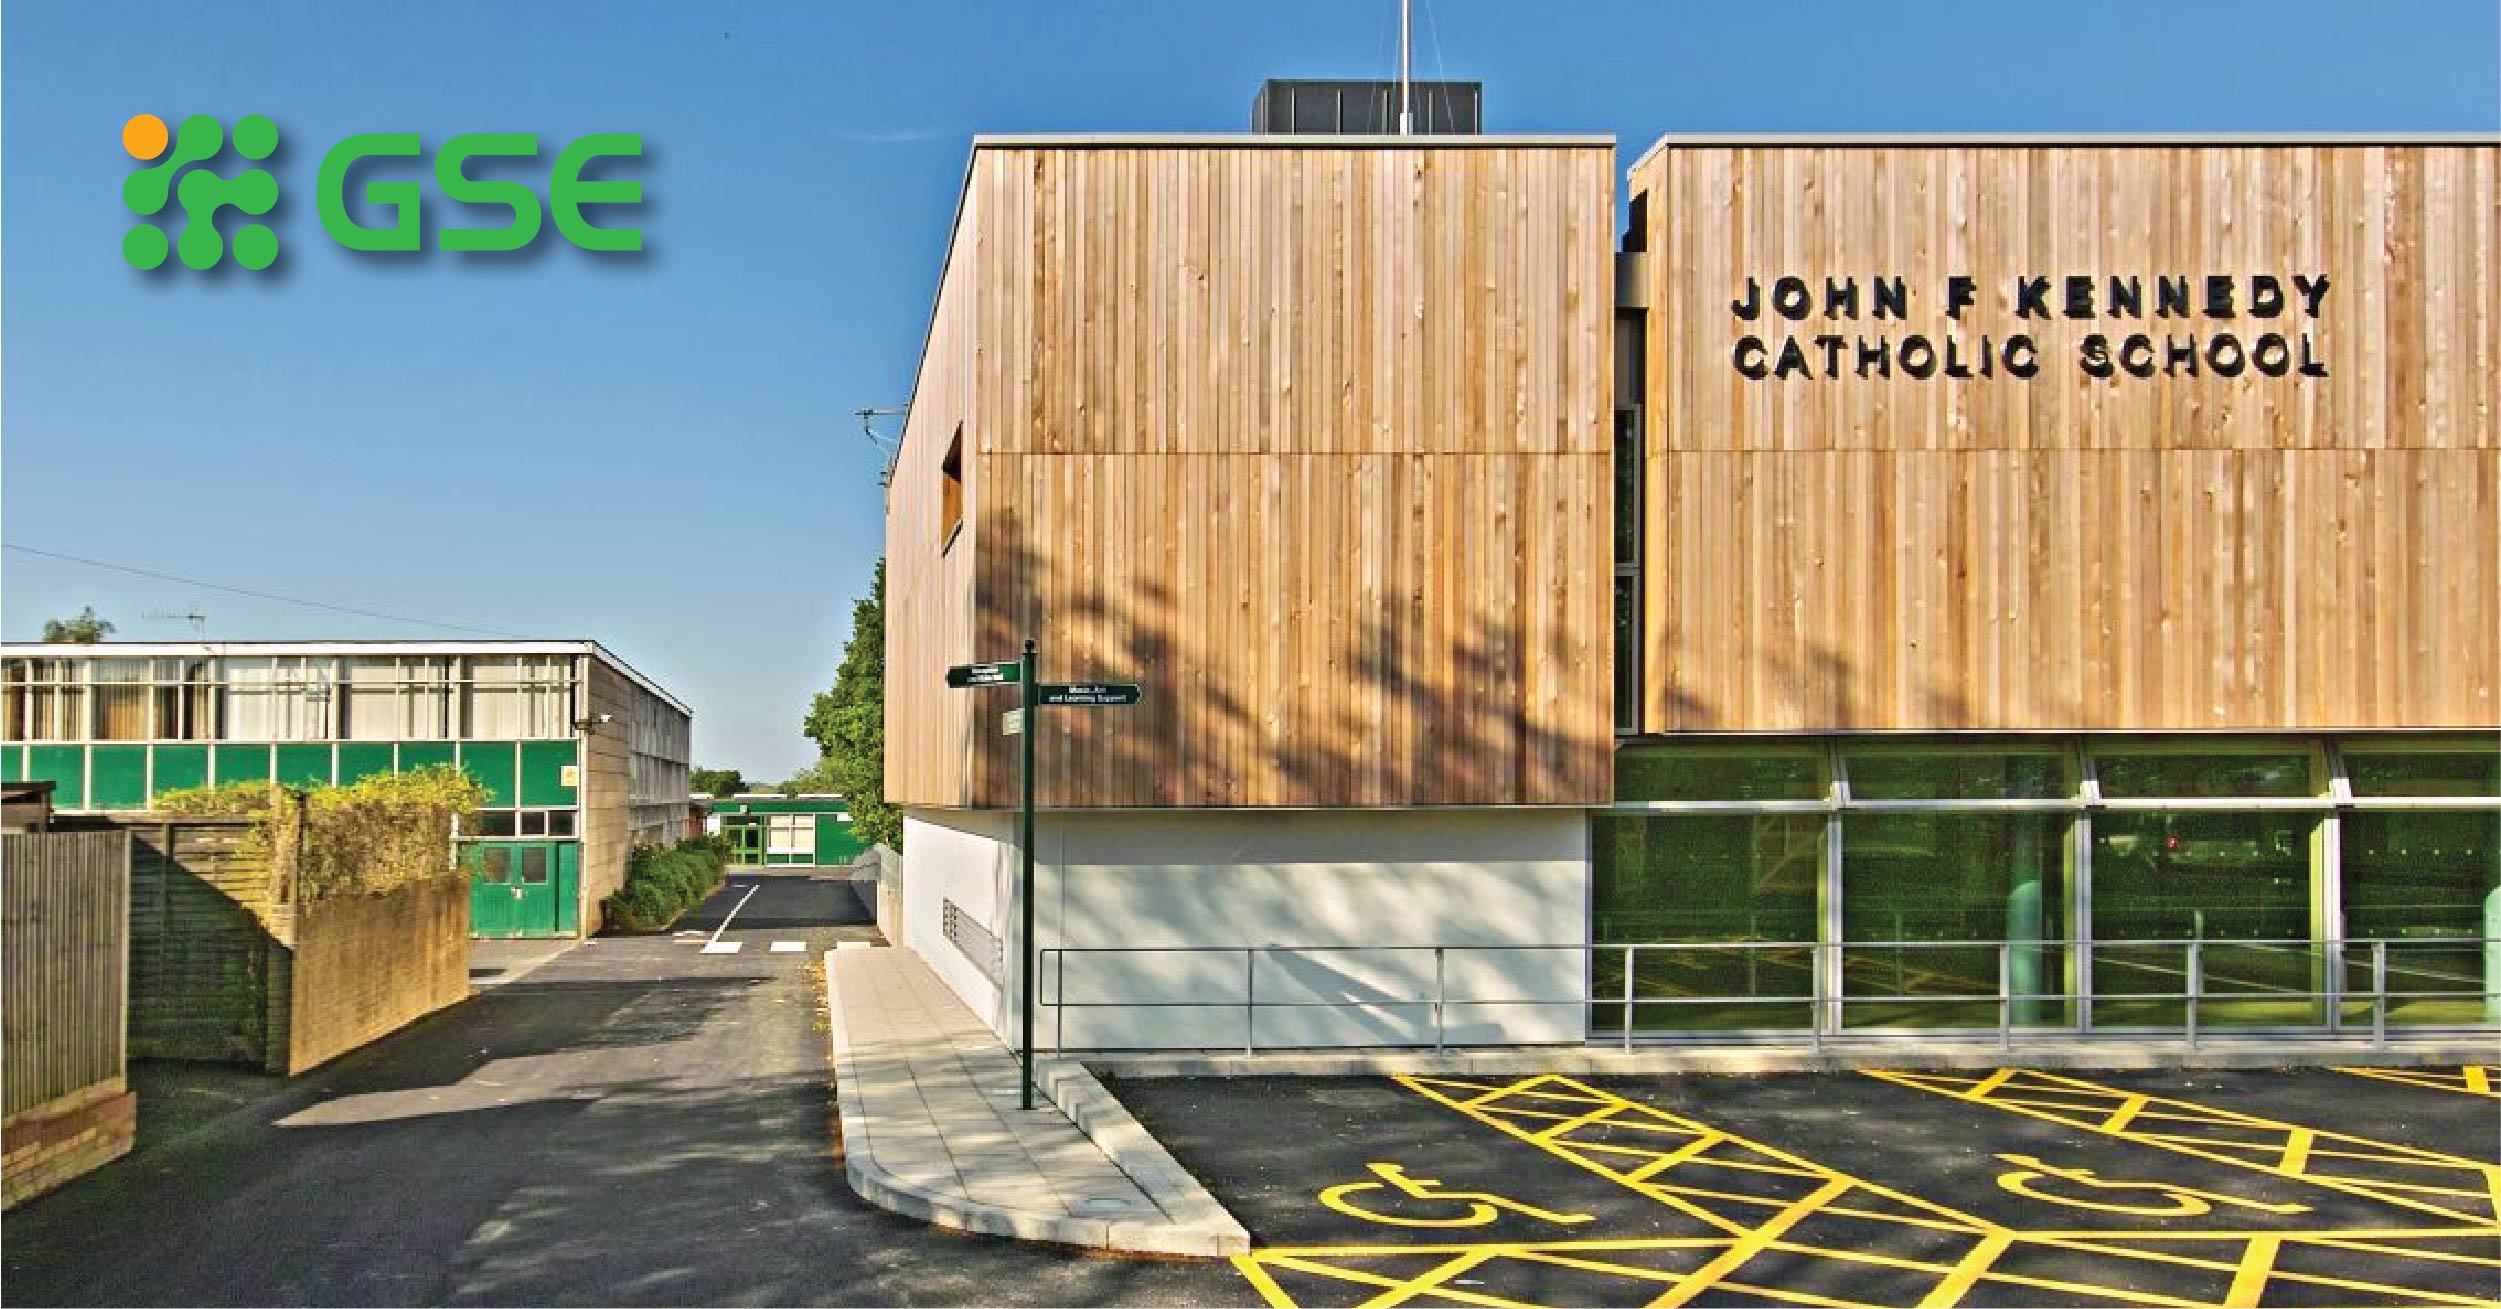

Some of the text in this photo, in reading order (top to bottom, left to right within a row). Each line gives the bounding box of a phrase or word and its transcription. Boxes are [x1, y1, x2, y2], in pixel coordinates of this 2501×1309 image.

[1732, 275, 2331, 320] JOHN F KENNEDY
[1731, 333, 2330, 380] CATHOLIC SCHOOL
